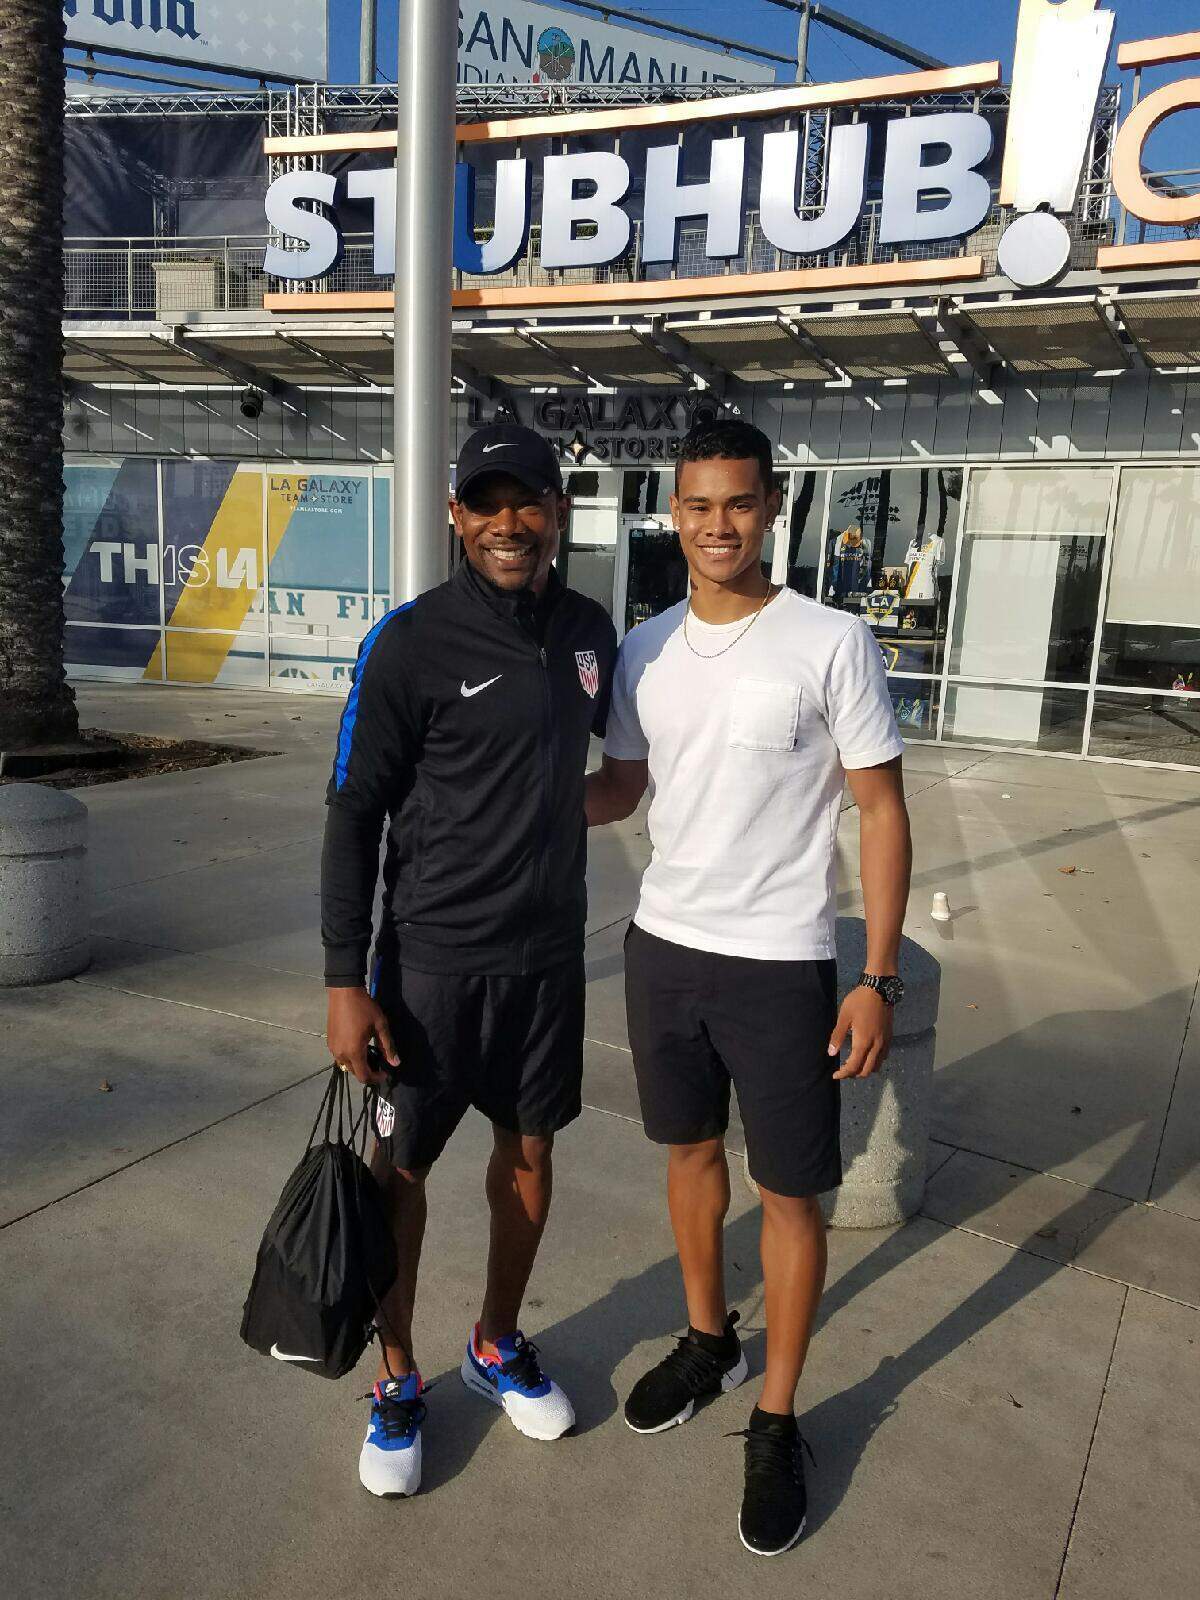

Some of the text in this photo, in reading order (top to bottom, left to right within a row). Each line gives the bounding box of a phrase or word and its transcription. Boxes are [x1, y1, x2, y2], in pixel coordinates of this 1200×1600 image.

[468, 396, 699, 431] LA GALAXY
[593, 436, 681, 459] STORE
[270, 477, 362, 494] LA GALAXY
[280, 493, 353, 504] TEAM STORE
[216, 547, 258, 590] LA
